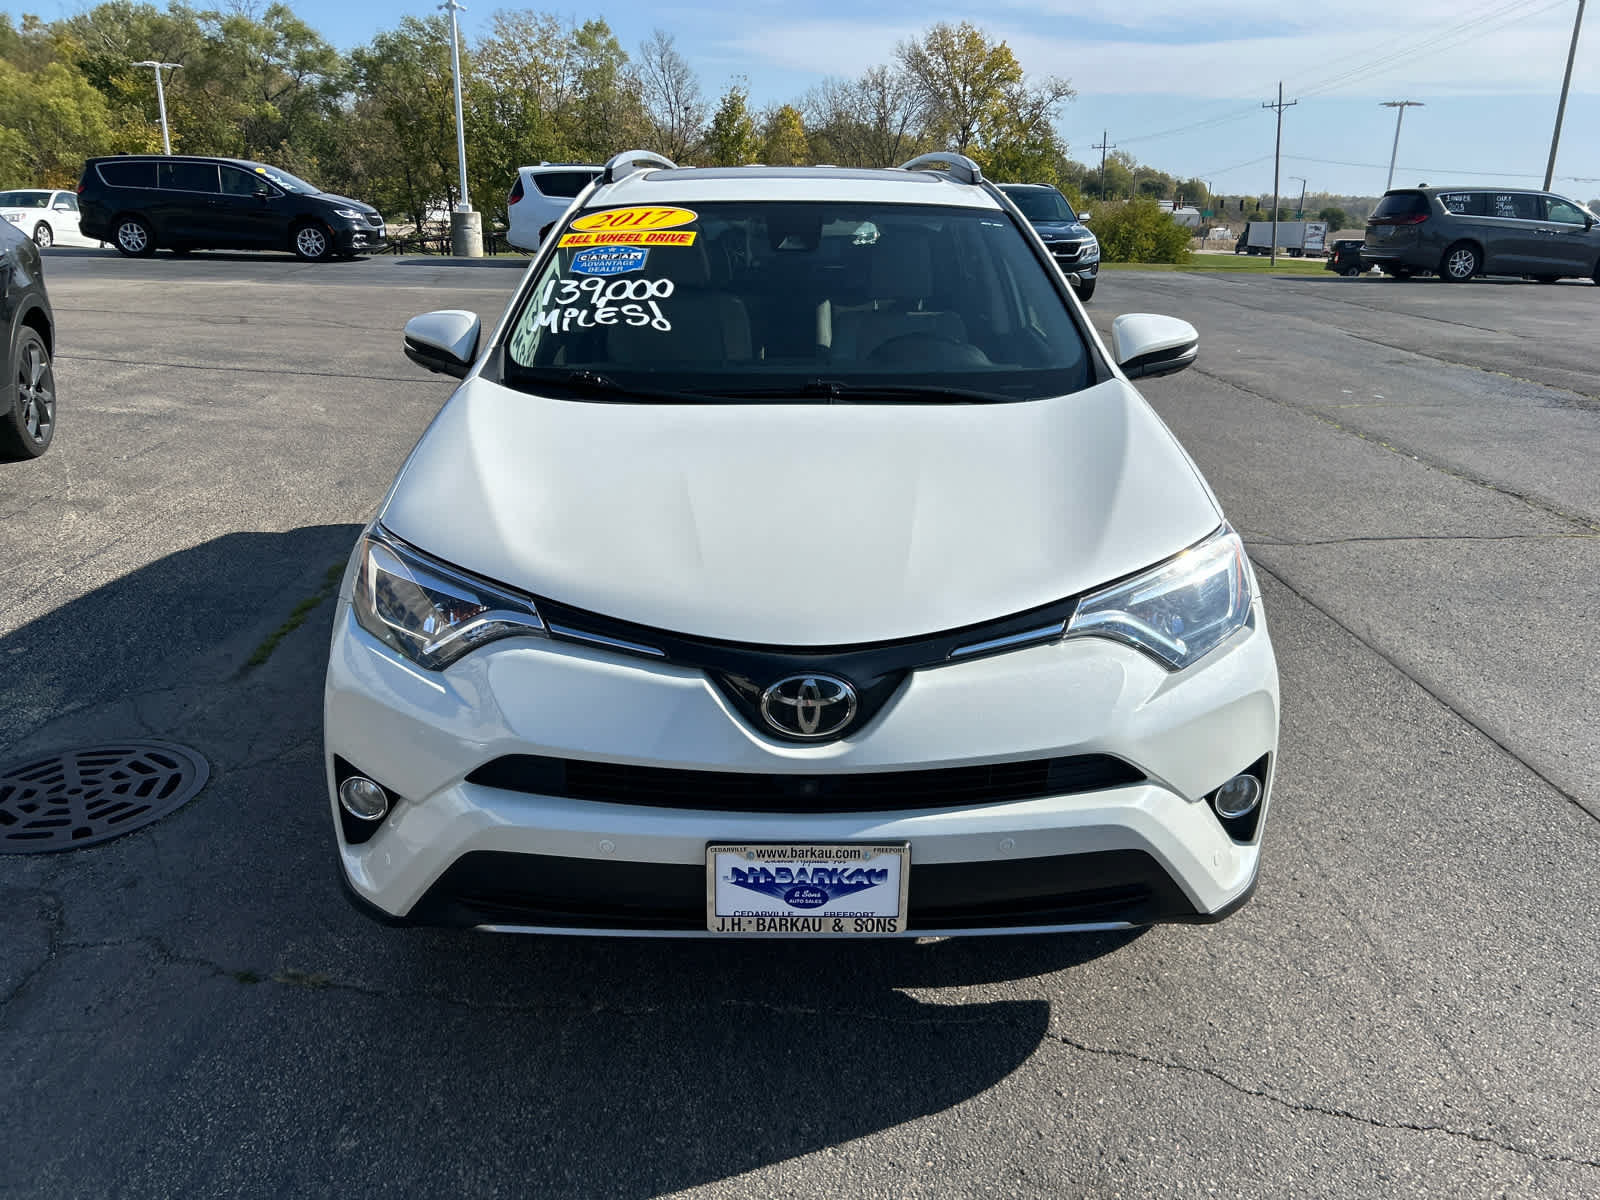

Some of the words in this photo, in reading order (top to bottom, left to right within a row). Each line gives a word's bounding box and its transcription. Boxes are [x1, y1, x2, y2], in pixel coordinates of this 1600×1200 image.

[585, 211, 677, 229] 2017
[564, 234, 592, 245] ALL
[595, 233, 643, 243] WHEEL
[645, 233, 691, 243] DRIVE
[580, 252, 643, 262] CARFAX
[542, 277, 675, 309] 139,000
[756, 847, 861, 859] www.barkau.com
[717, 918, 746, 932] J.H.
[756, 918, 822, 932] BARKAU
[831, 918, 844, 932] &
[854, 918, 897, 932] SONS
